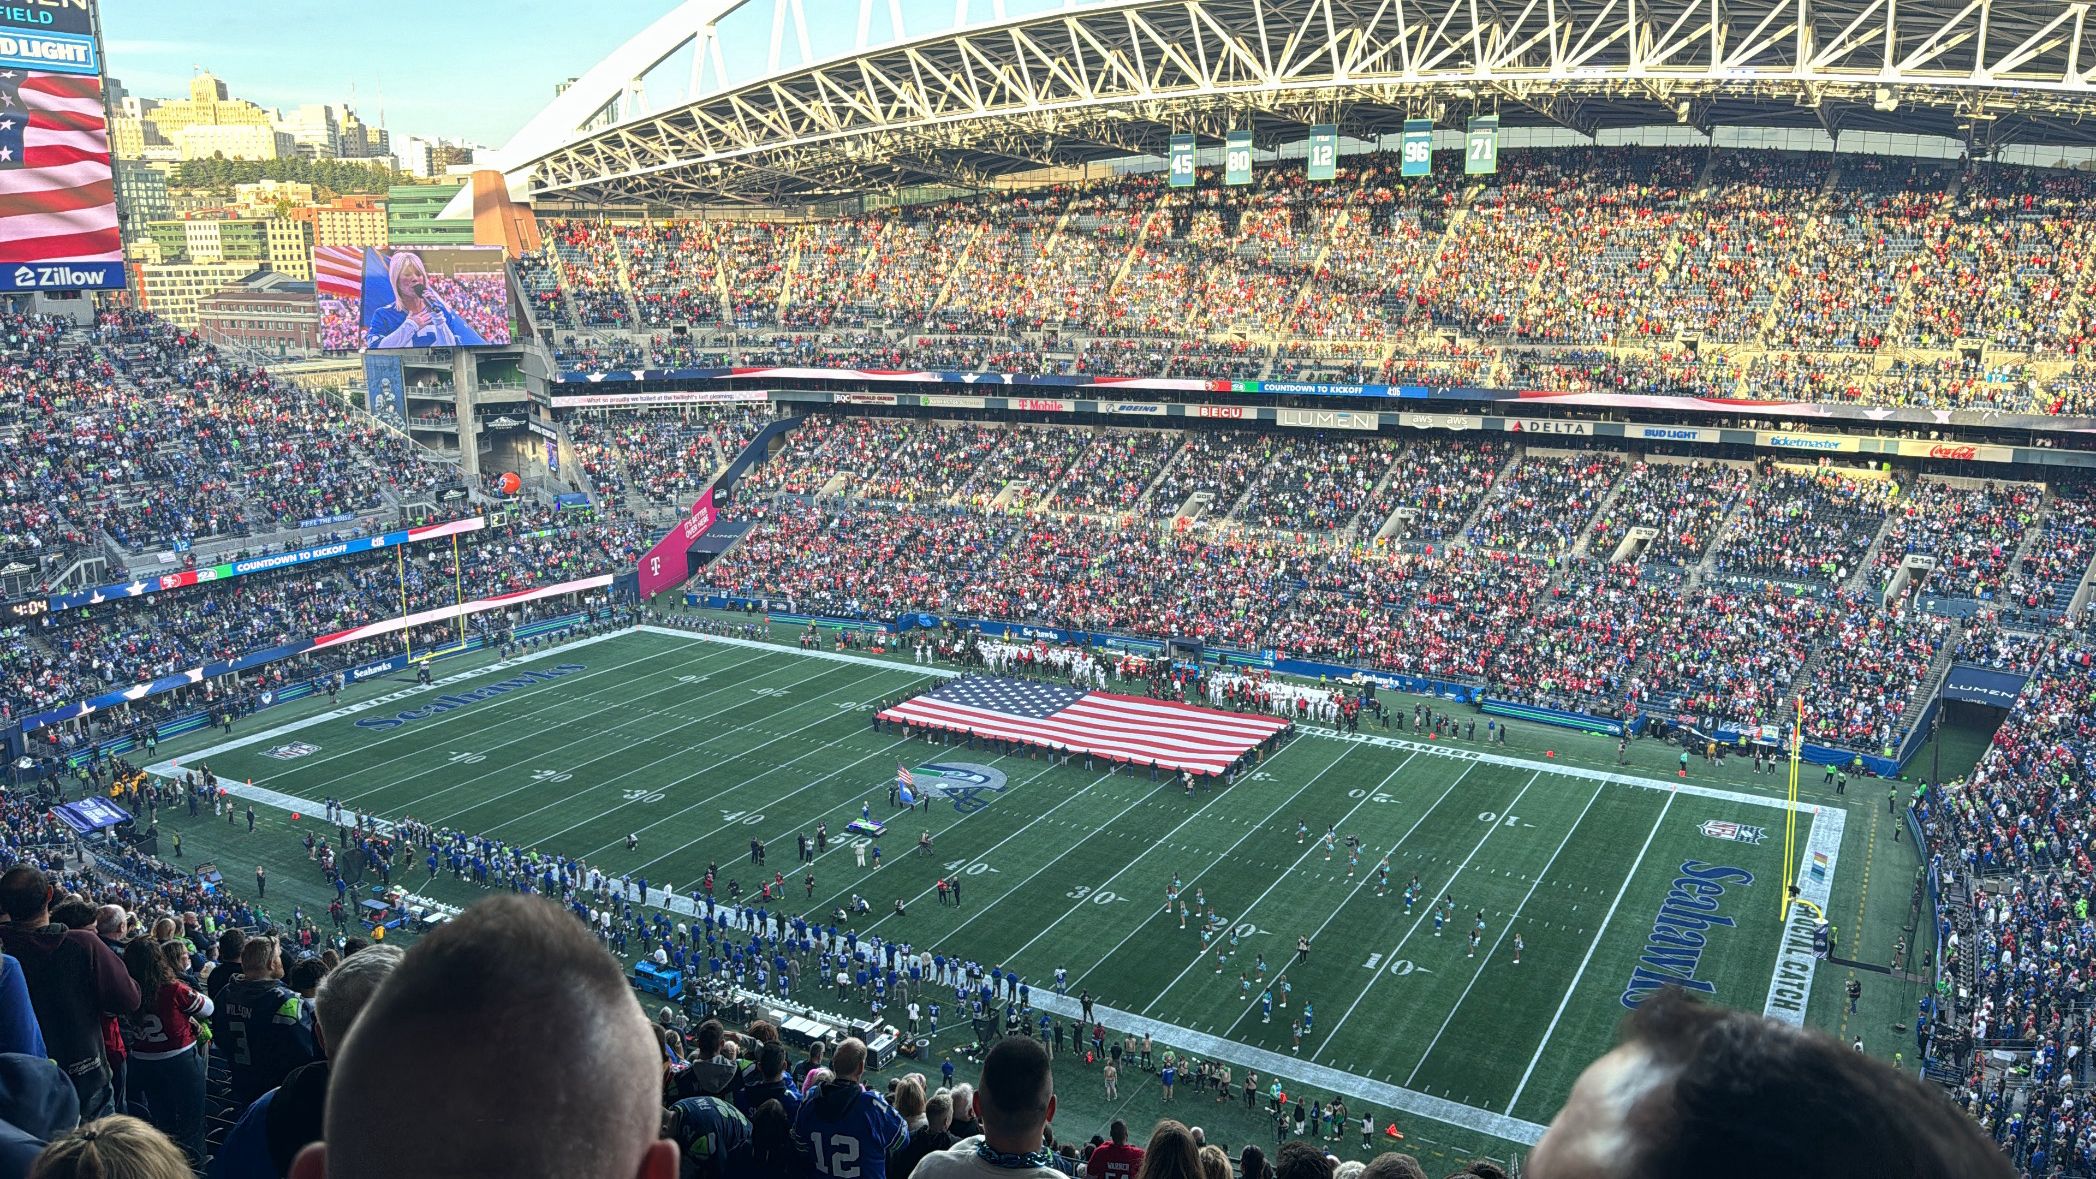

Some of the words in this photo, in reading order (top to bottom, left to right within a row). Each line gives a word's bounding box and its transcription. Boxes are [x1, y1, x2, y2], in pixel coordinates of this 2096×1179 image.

[19, 39, 88, 62] LIGHT
[1312, 146, 1332, 166] 12
[1404, 142, 1430, 162] 96
[1471, 138, 1492, 160] 71
[1171, 154, 1192, 174] 45
[1228, 151, 1250, 172] 80
[37, 267, 104, 286] Zillow
[1264, 384, 1315, 393] COUNTDOWN
[1330, 386, 1363, 394] KICKOFF
[1284, 412, 1371, 428] LUMEN
[1413, 415, 1433, 425] aws
[1446, 416, 1468, 426] aws
[1530, 421, 1584, 434] DELTA
[1644, 428, 1665, 439] BUD
[1666, 429, 1698, 440] LIGHT
[1770, 436, 1840, 449] ticketmaster
[178, 542, 188, 552] 12
[236, 553, 297, 572] COUNTDOWN
[299, 551, 311, 560] TO
[313, 544, 347, 558] KICKOFF
[13, 600, 48, 616] 4:04
[354, 662, 392, 679] Seahawks
[353, 663, 588, 732] Seahawks
[1949, 684, 2014, 699] LUMEN
[1386, 740, 1480, 758] CANCER
[943, 858, 988, 875] 40
[1066, 886, 1116, 905] 30
[1362, 952, 1414, 976] 10
[1772, 960, 1809, 1012] CATCH
[810, 1130, 861, 1179] 12
